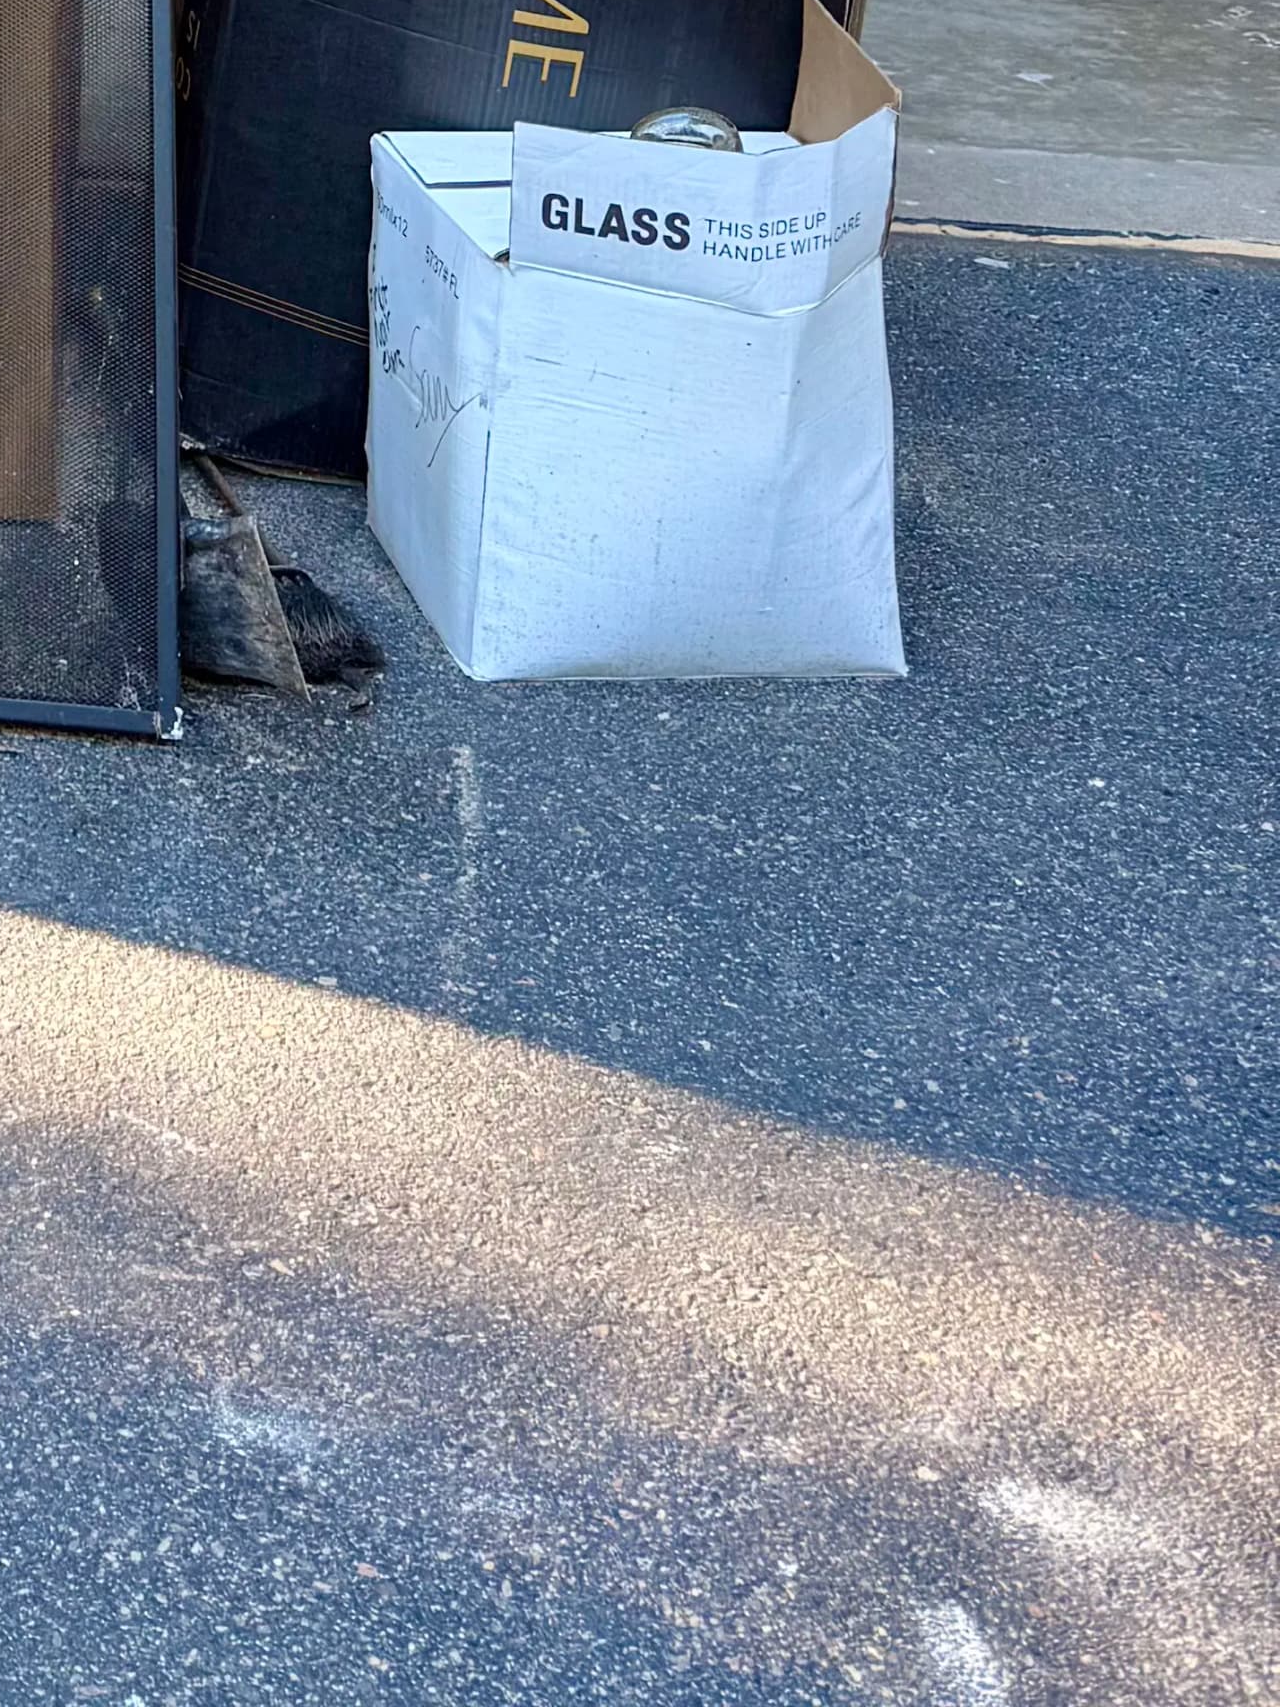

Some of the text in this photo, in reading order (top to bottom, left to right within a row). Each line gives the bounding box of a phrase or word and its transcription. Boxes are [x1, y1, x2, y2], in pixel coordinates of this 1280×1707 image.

[541, 192, 691, 251] GLASS
[702, 211, 863, 263] HANDLE WITH CARE
[704, 212, 828, 241] THIS SIDE UP
